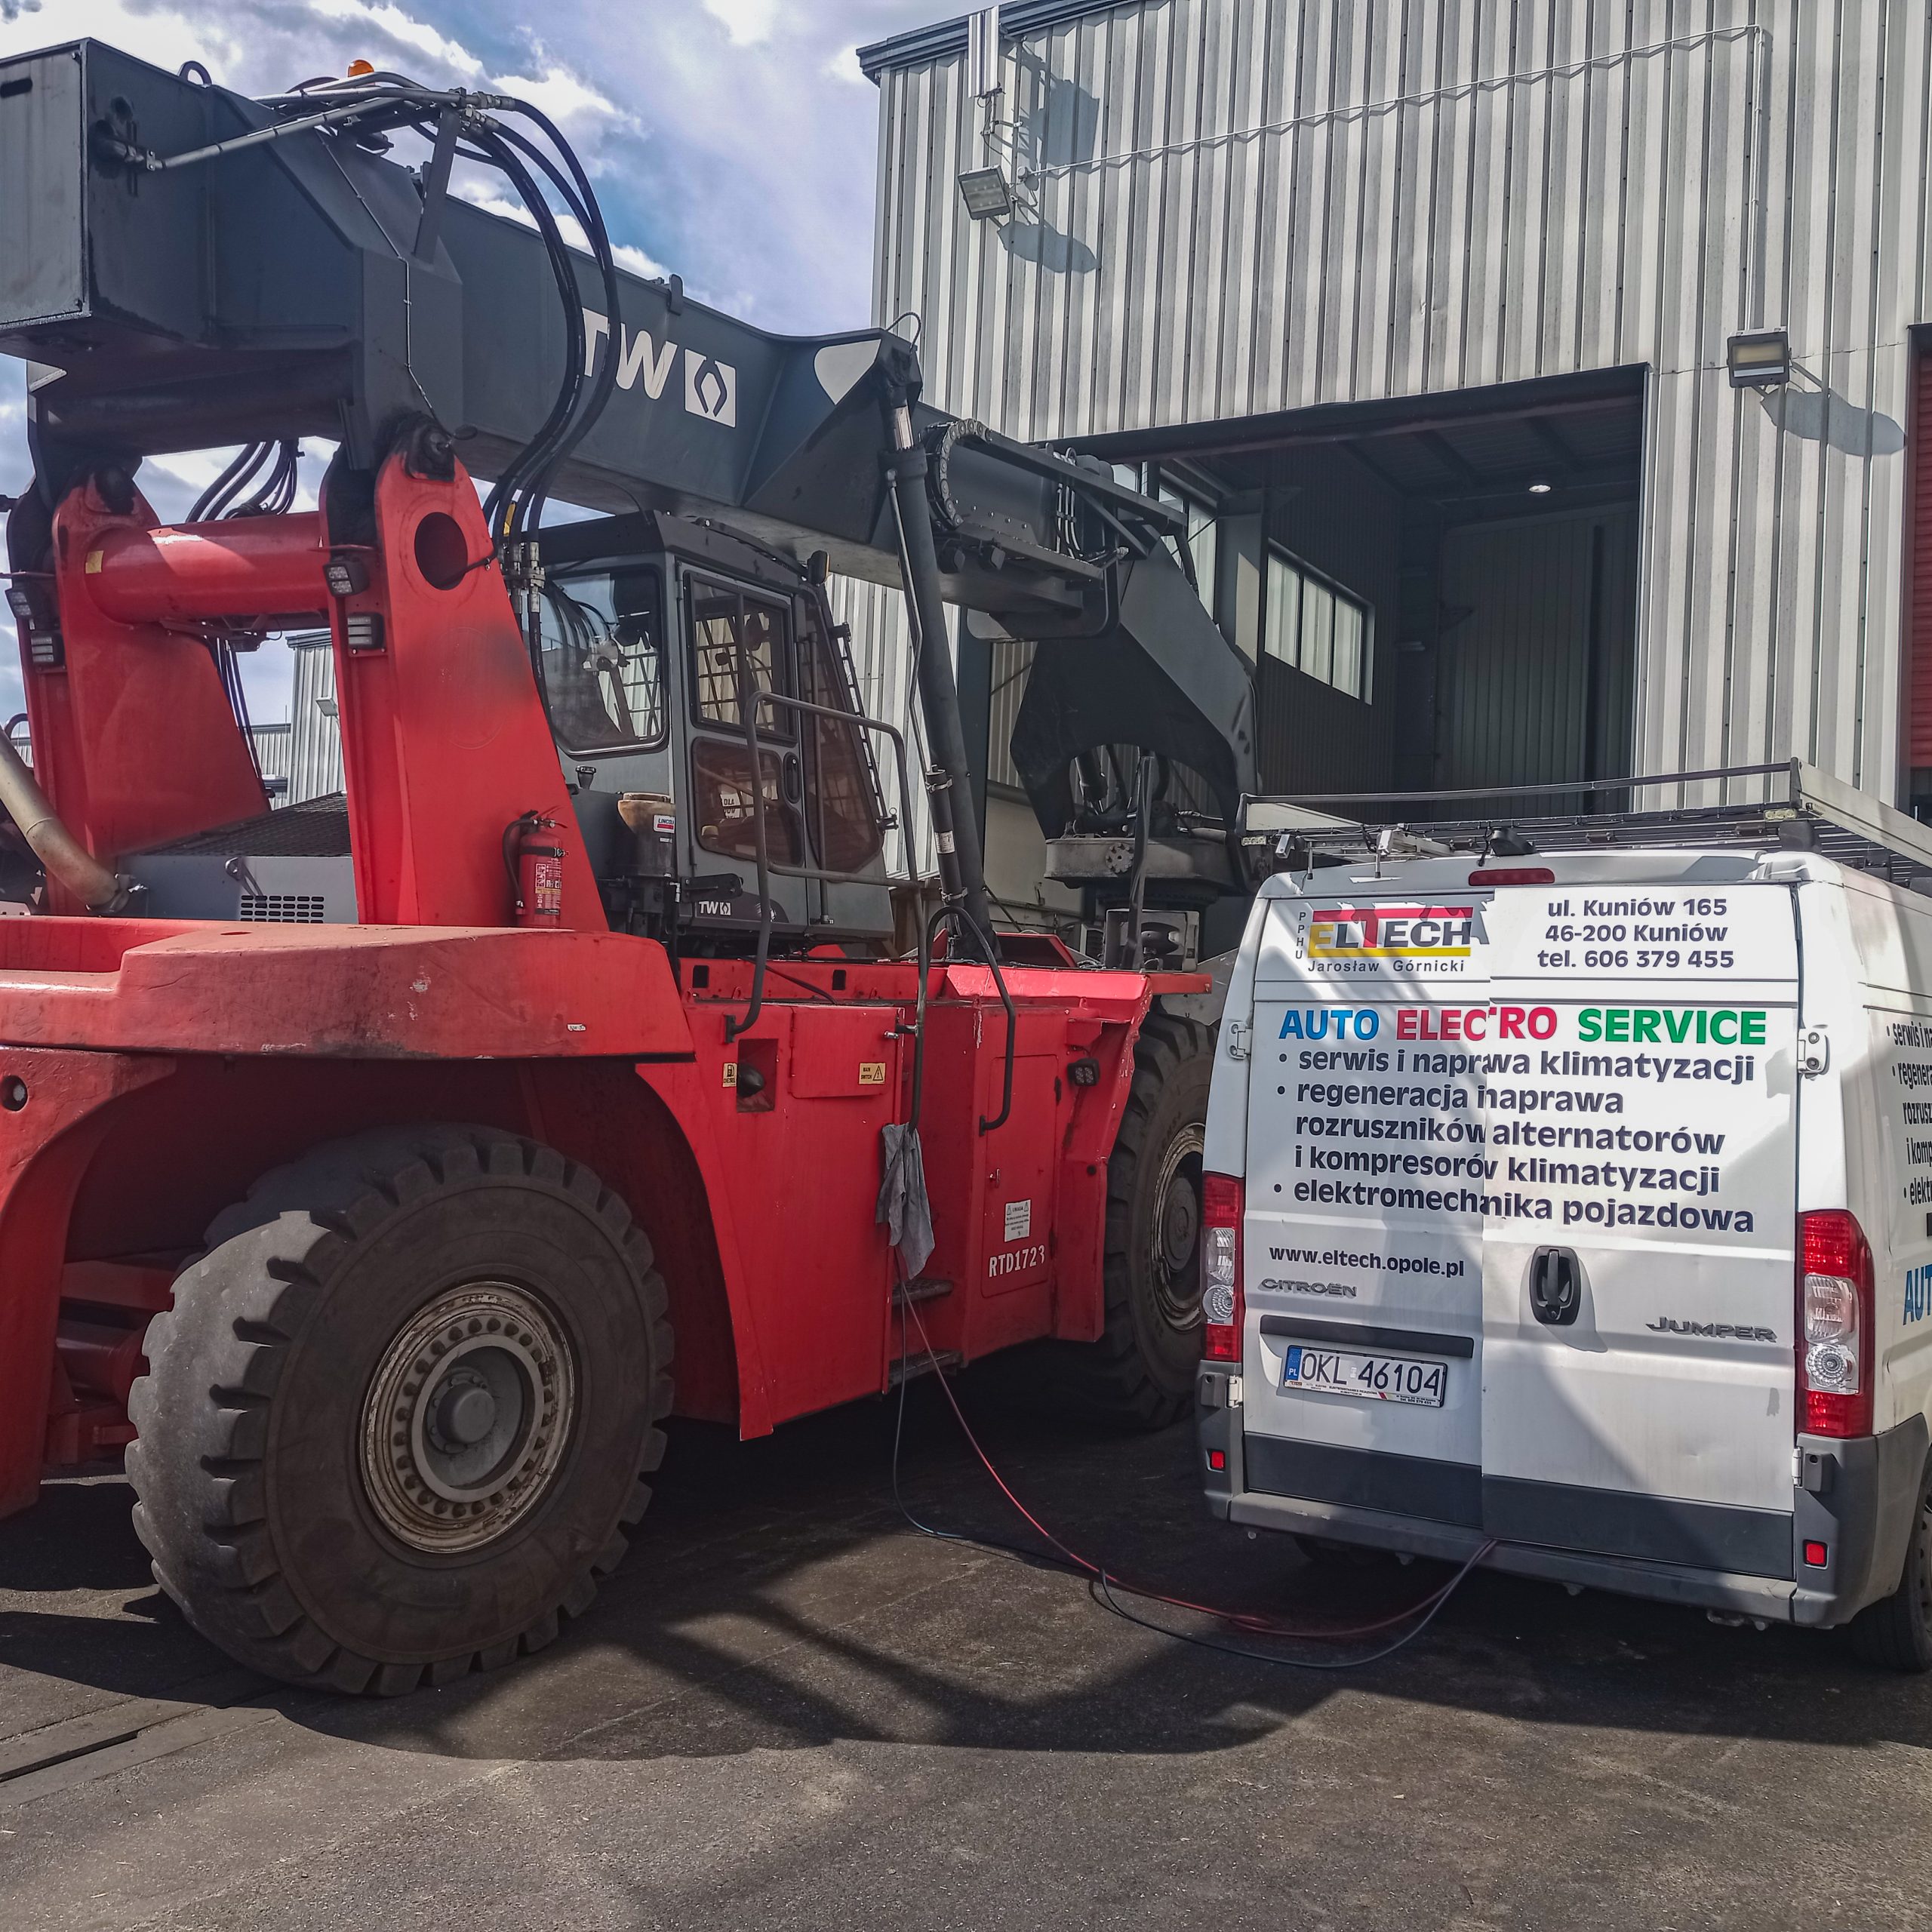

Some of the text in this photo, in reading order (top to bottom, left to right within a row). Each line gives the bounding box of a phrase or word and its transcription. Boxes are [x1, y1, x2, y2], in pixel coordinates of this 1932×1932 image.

[699, 900, 718, 914] TW
[1548, 898, 1727, 916] ul. Kuniów 165
[1308, 908, 1472, 957] ELTECH
[1546, 923, 1727, 942] 46-200 Kuniów
[1308, 959, 1464, 972] Jarosław Górnicki
[1537, 949, 1734, 968] tel. 606 379 455
[1278, 1007, 1767, 1045] AUTO ELECRO SERVICE
[1893, 1021, 1920, 1048] serwis
[1299, 1048, 1389, 1072] serwis
[1397, 1049, 1405, 1072] i
[1540, 1051, 1754, 1084] klimatyzacji
[1297, 1082, 1468, 1111] regeneracja
[1478, 1084, 1485, 1109] i
[1296, 1115, 1725, 1154] rozruszników alternatorów
[1294, 1145, 1303, 1168] i
[1509, 1156, 1720, 1195] klimatyzacji
[1563, 1198, 1754, 1232] pojazdowa
[989, 1244, 1044, 1277] RTD1723
[1269, 1247, 1464, 1278] www.eltech.opole.pl
[1261, 1278, 1357, 1297] CITROËN
[1646, 1316, 1777, 1343] JUMPER
[1288, 1353, 1441, 1396] PL OKL 46104
